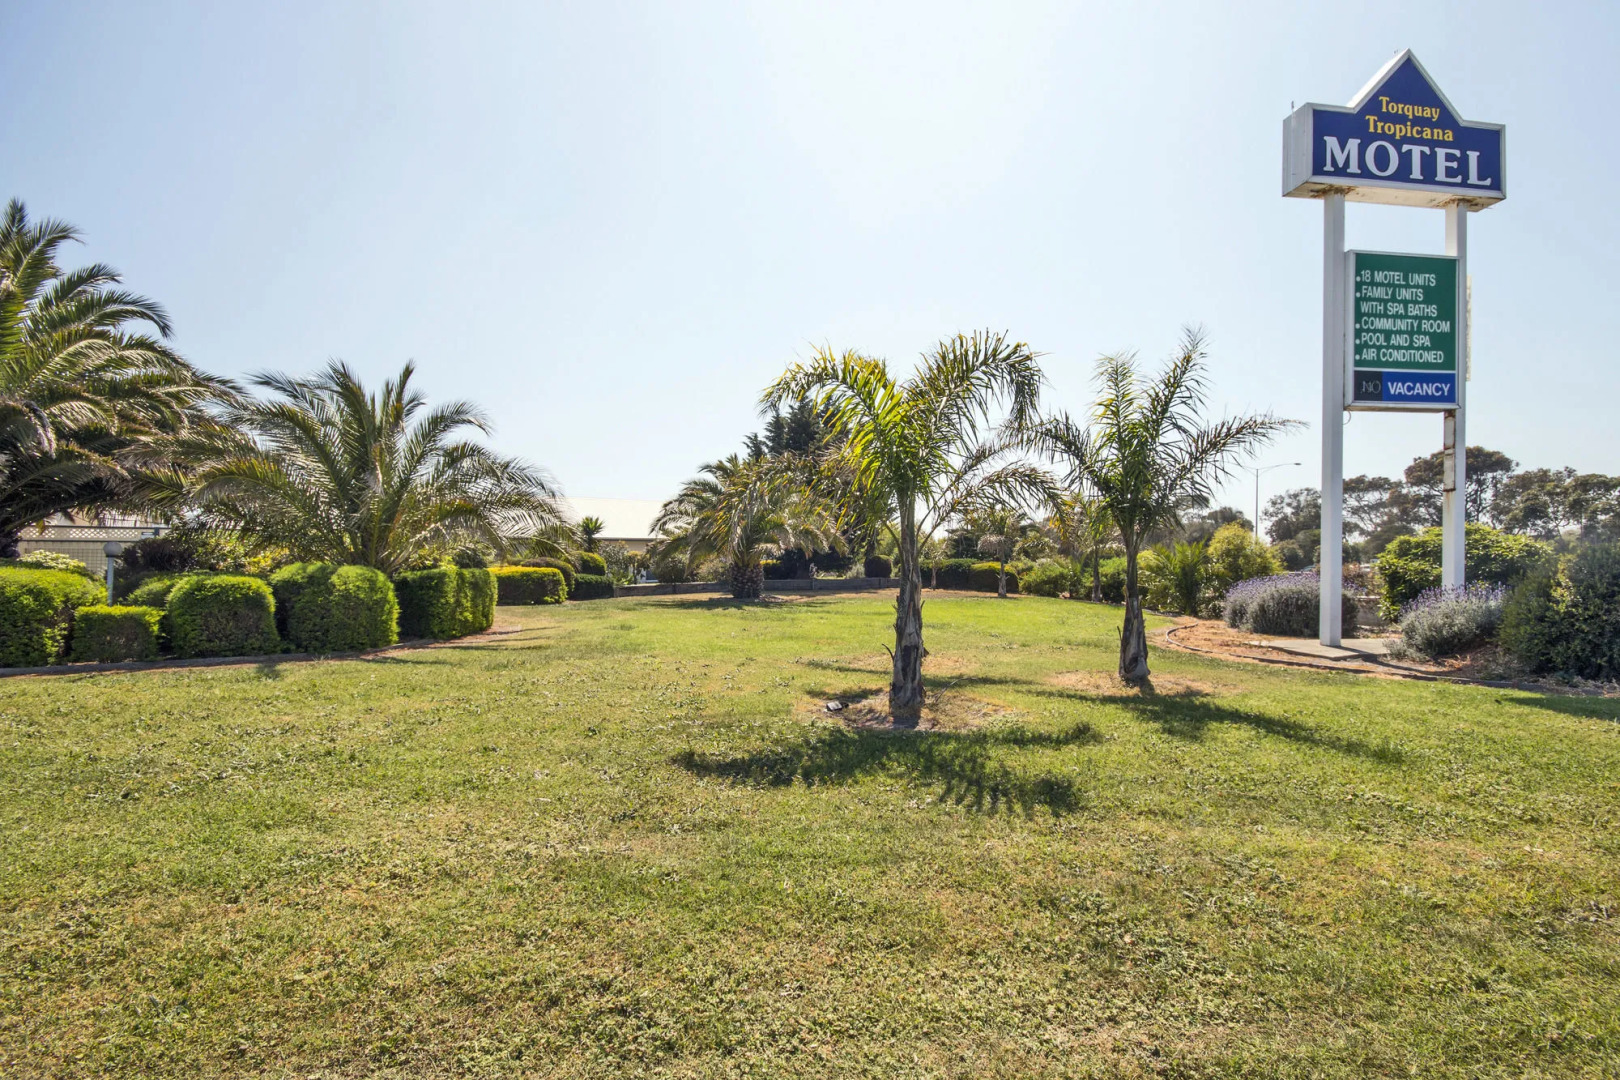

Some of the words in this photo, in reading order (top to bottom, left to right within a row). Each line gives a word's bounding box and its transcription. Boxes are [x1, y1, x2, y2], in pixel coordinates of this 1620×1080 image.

[1379, 96, 1440, 122] Torquay
[1365, 115, 1453, 141] Tropicana
[1323, 136, 1492, 186] MOTEL
[1360, 270, 1371, 282] 18
[1374, 271, 1406, 284] MOTEL
[1408, 273, 1436, 286] UNITS
[1361, 286, 1393, 299] FAMILY
[1396, 288, 1424, 301] UNITS
[1360, 301, 1384, 314] WITH
[1387, 303, 1405, 315] SPA
[1408, 304, 1438, 317] BATHS
[1361, 317, 1419, 331] COMMUNITY
[1421, 320, 1450, 333] ROOM
[1361, 333, 1387, 345] POOL
[1390, 334, 1410, 346] AND
[1413, 335, 1431, 347] SPA
[1361, 349, 1377, 361] AIR
[1380, 350, 1444, 363] CONDITIONED
[1361, 380, 1381, 394] NO
[1388, 382, 1450, 396] VACANCY
